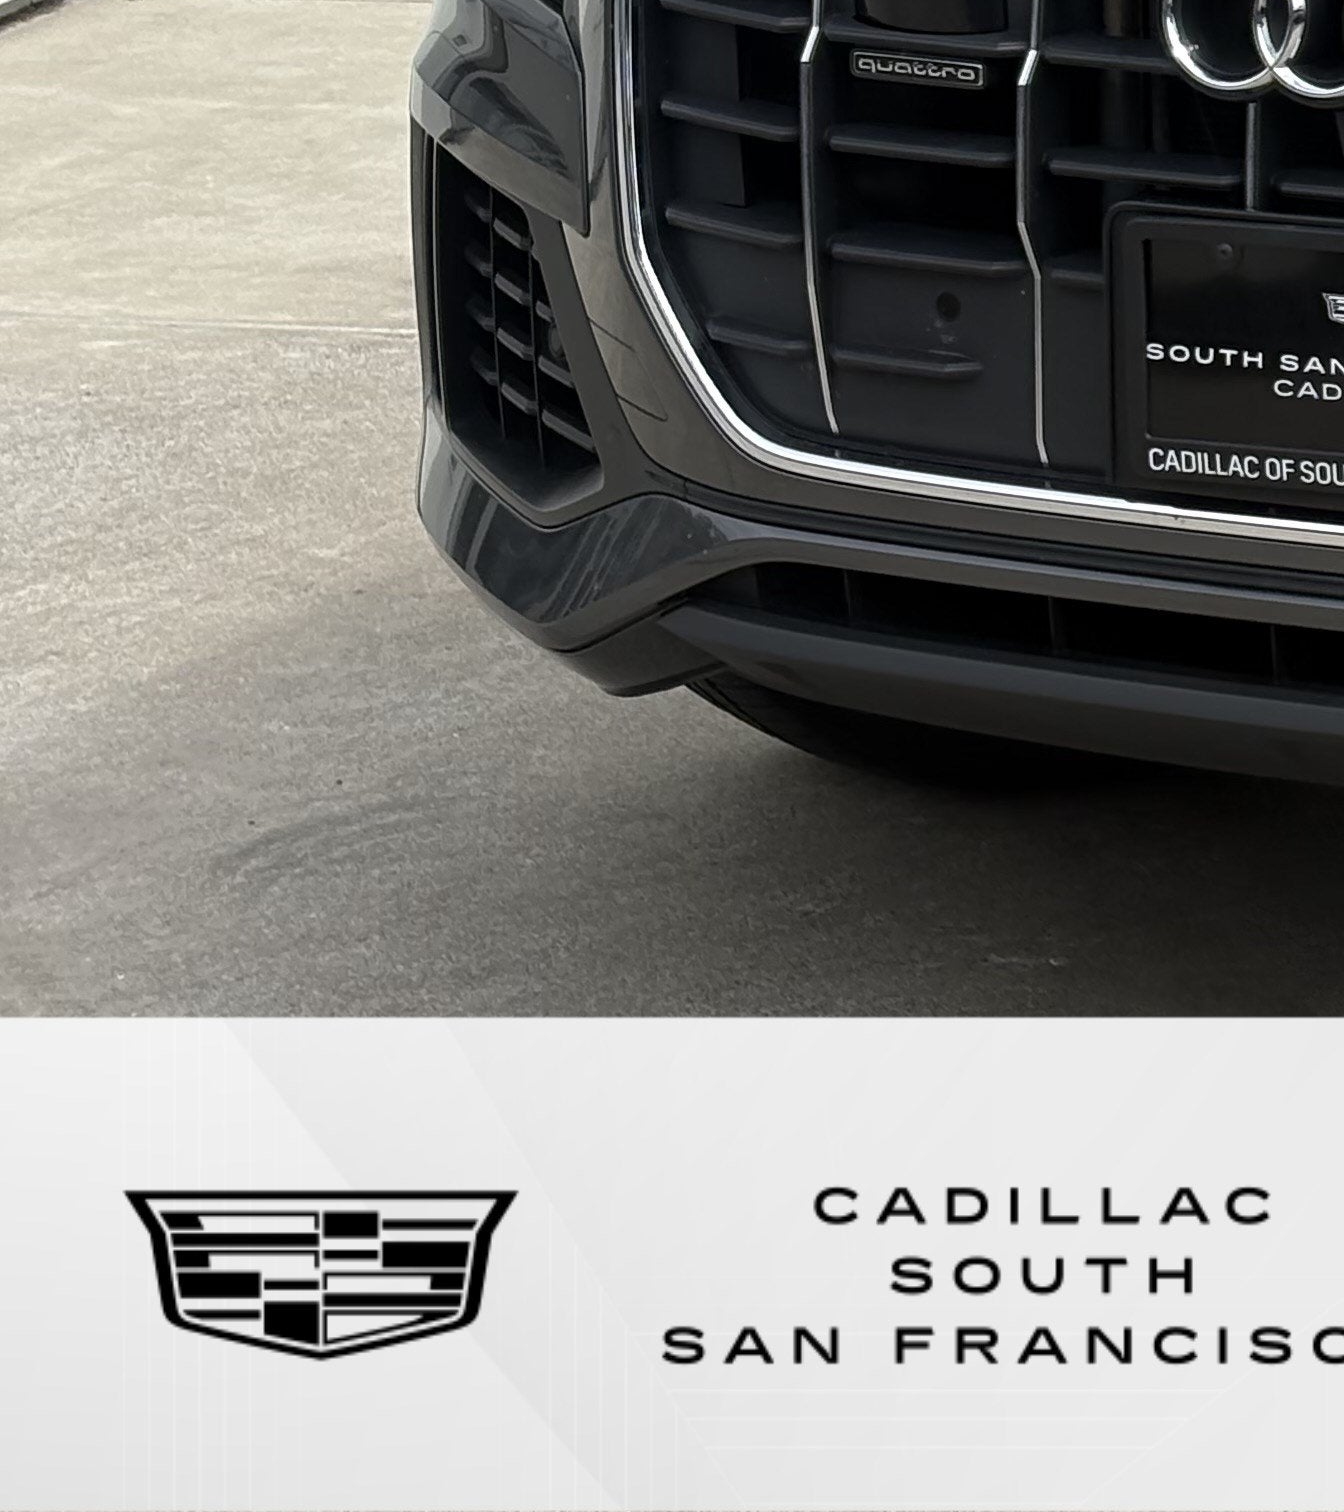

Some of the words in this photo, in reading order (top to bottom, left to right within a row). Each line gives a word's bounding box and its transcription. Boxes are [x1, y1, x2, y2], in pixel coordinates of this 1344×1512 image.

[858, 57, 976, 81] quattro
[1146, 342, 1263, 369] SOUTH
[1148, 447, 1260, 479] CADILLAC
[1264, 457, 1295, 482] OF
